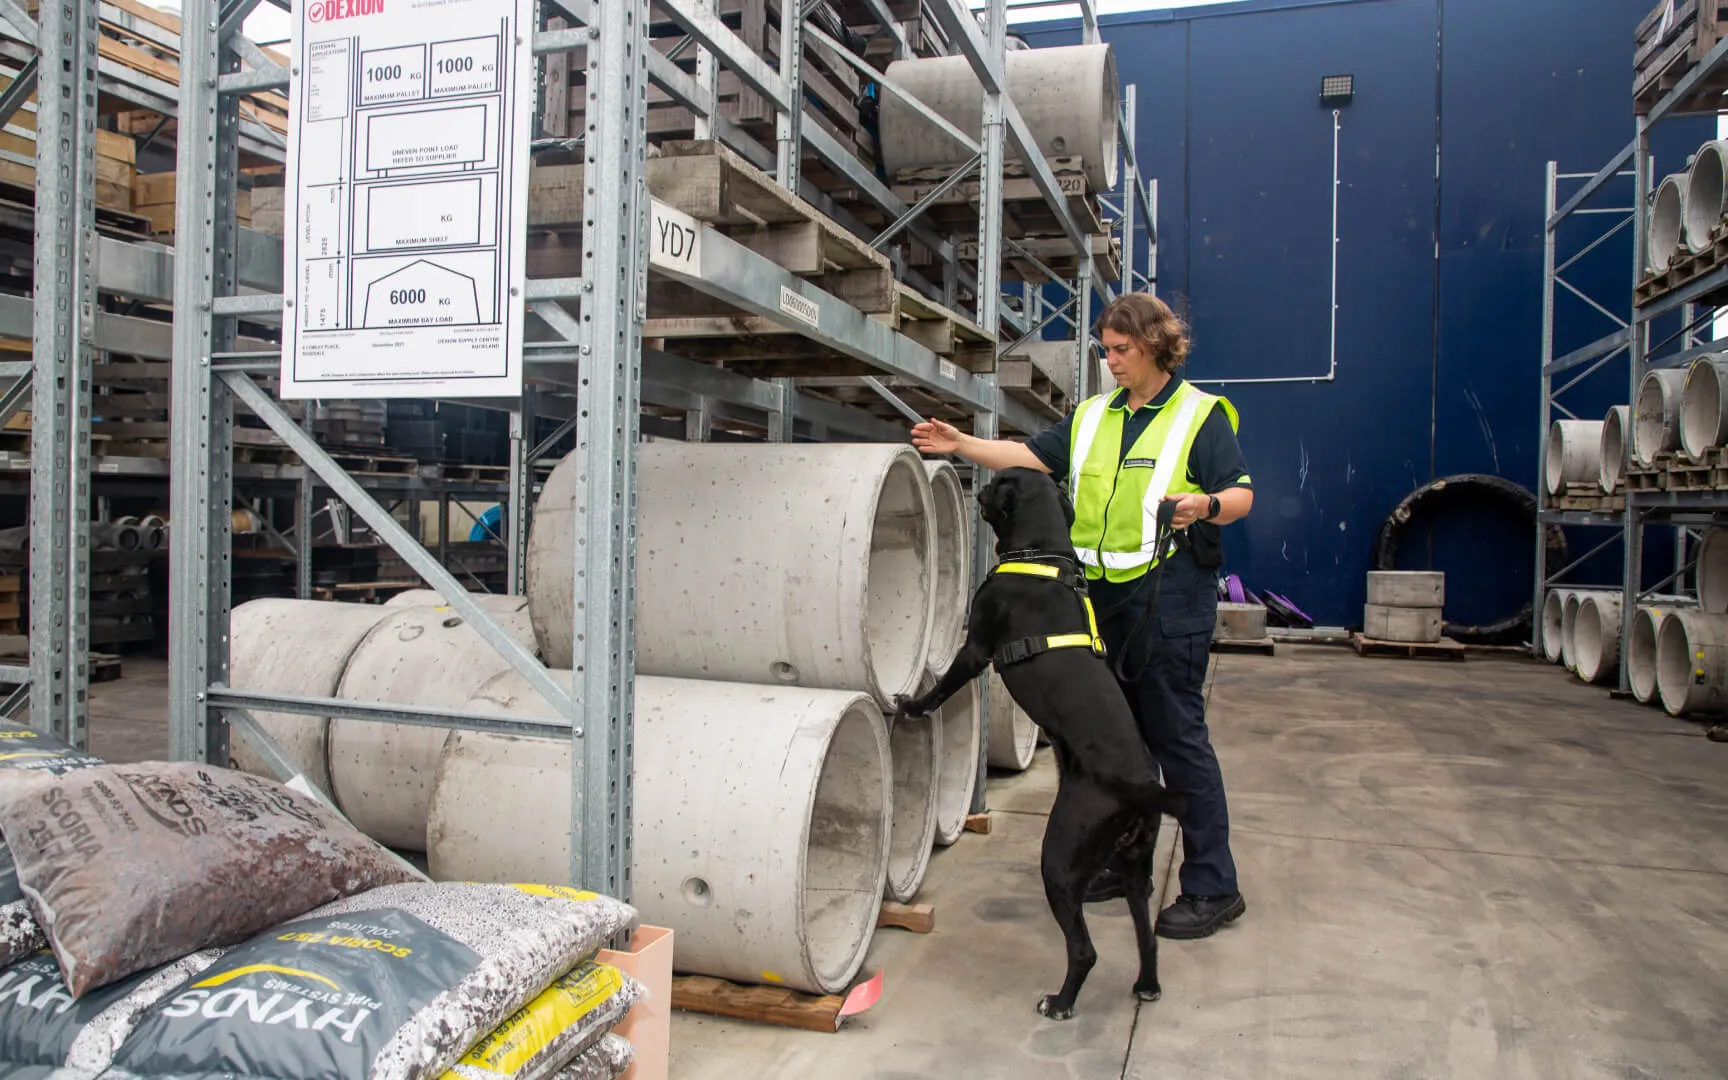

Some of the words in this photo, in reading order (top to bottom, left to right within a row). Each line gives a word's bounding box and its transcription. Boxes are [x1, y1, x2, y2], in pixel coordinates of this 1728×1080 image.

[325, 0, 384, 21] DEXION
[366, 65, 402, 83] 1000
[410, 72, 422, 80] KG
[436, 56, 473, 75] 1000
[482, 64, 494, 73] KG
[364, 92, 396, 101] MAXIMUM
[396, 90, 420, 98] PALLET
[434, 85, 467, 94] MAXIMUM
[467, 82, 493, 90] PALLET
[392, 148, 418, 156] UNEVEN
[420, 146, 439, 154] POINT
[440, 144, 458, 152] LOAD
[392, 156, 414, 164] REFER
[415, 155, 425, 163] TO
[427, 153, 457, 162] SUPPLIER
[440, 214, 452, 223] KG
[396, 237, 427, 245] MAXIMUM
[657, 216, 696, 263] YD7
[390, 288, 426, 305] 6000
[439, 298, 450, 306] KG
[388, 317, 420, 326] MAXIMUM
[435, 316, 453, 324] LOAD
[42, 787, 103, 864] SCORIA
[328, 935, 413, 958] SCORIA
[263, 979, 339, 1005] SYSTEMS
[343, 991, 383, 1010] PIPE
[162, 987, 371, 1043] HYNDS
